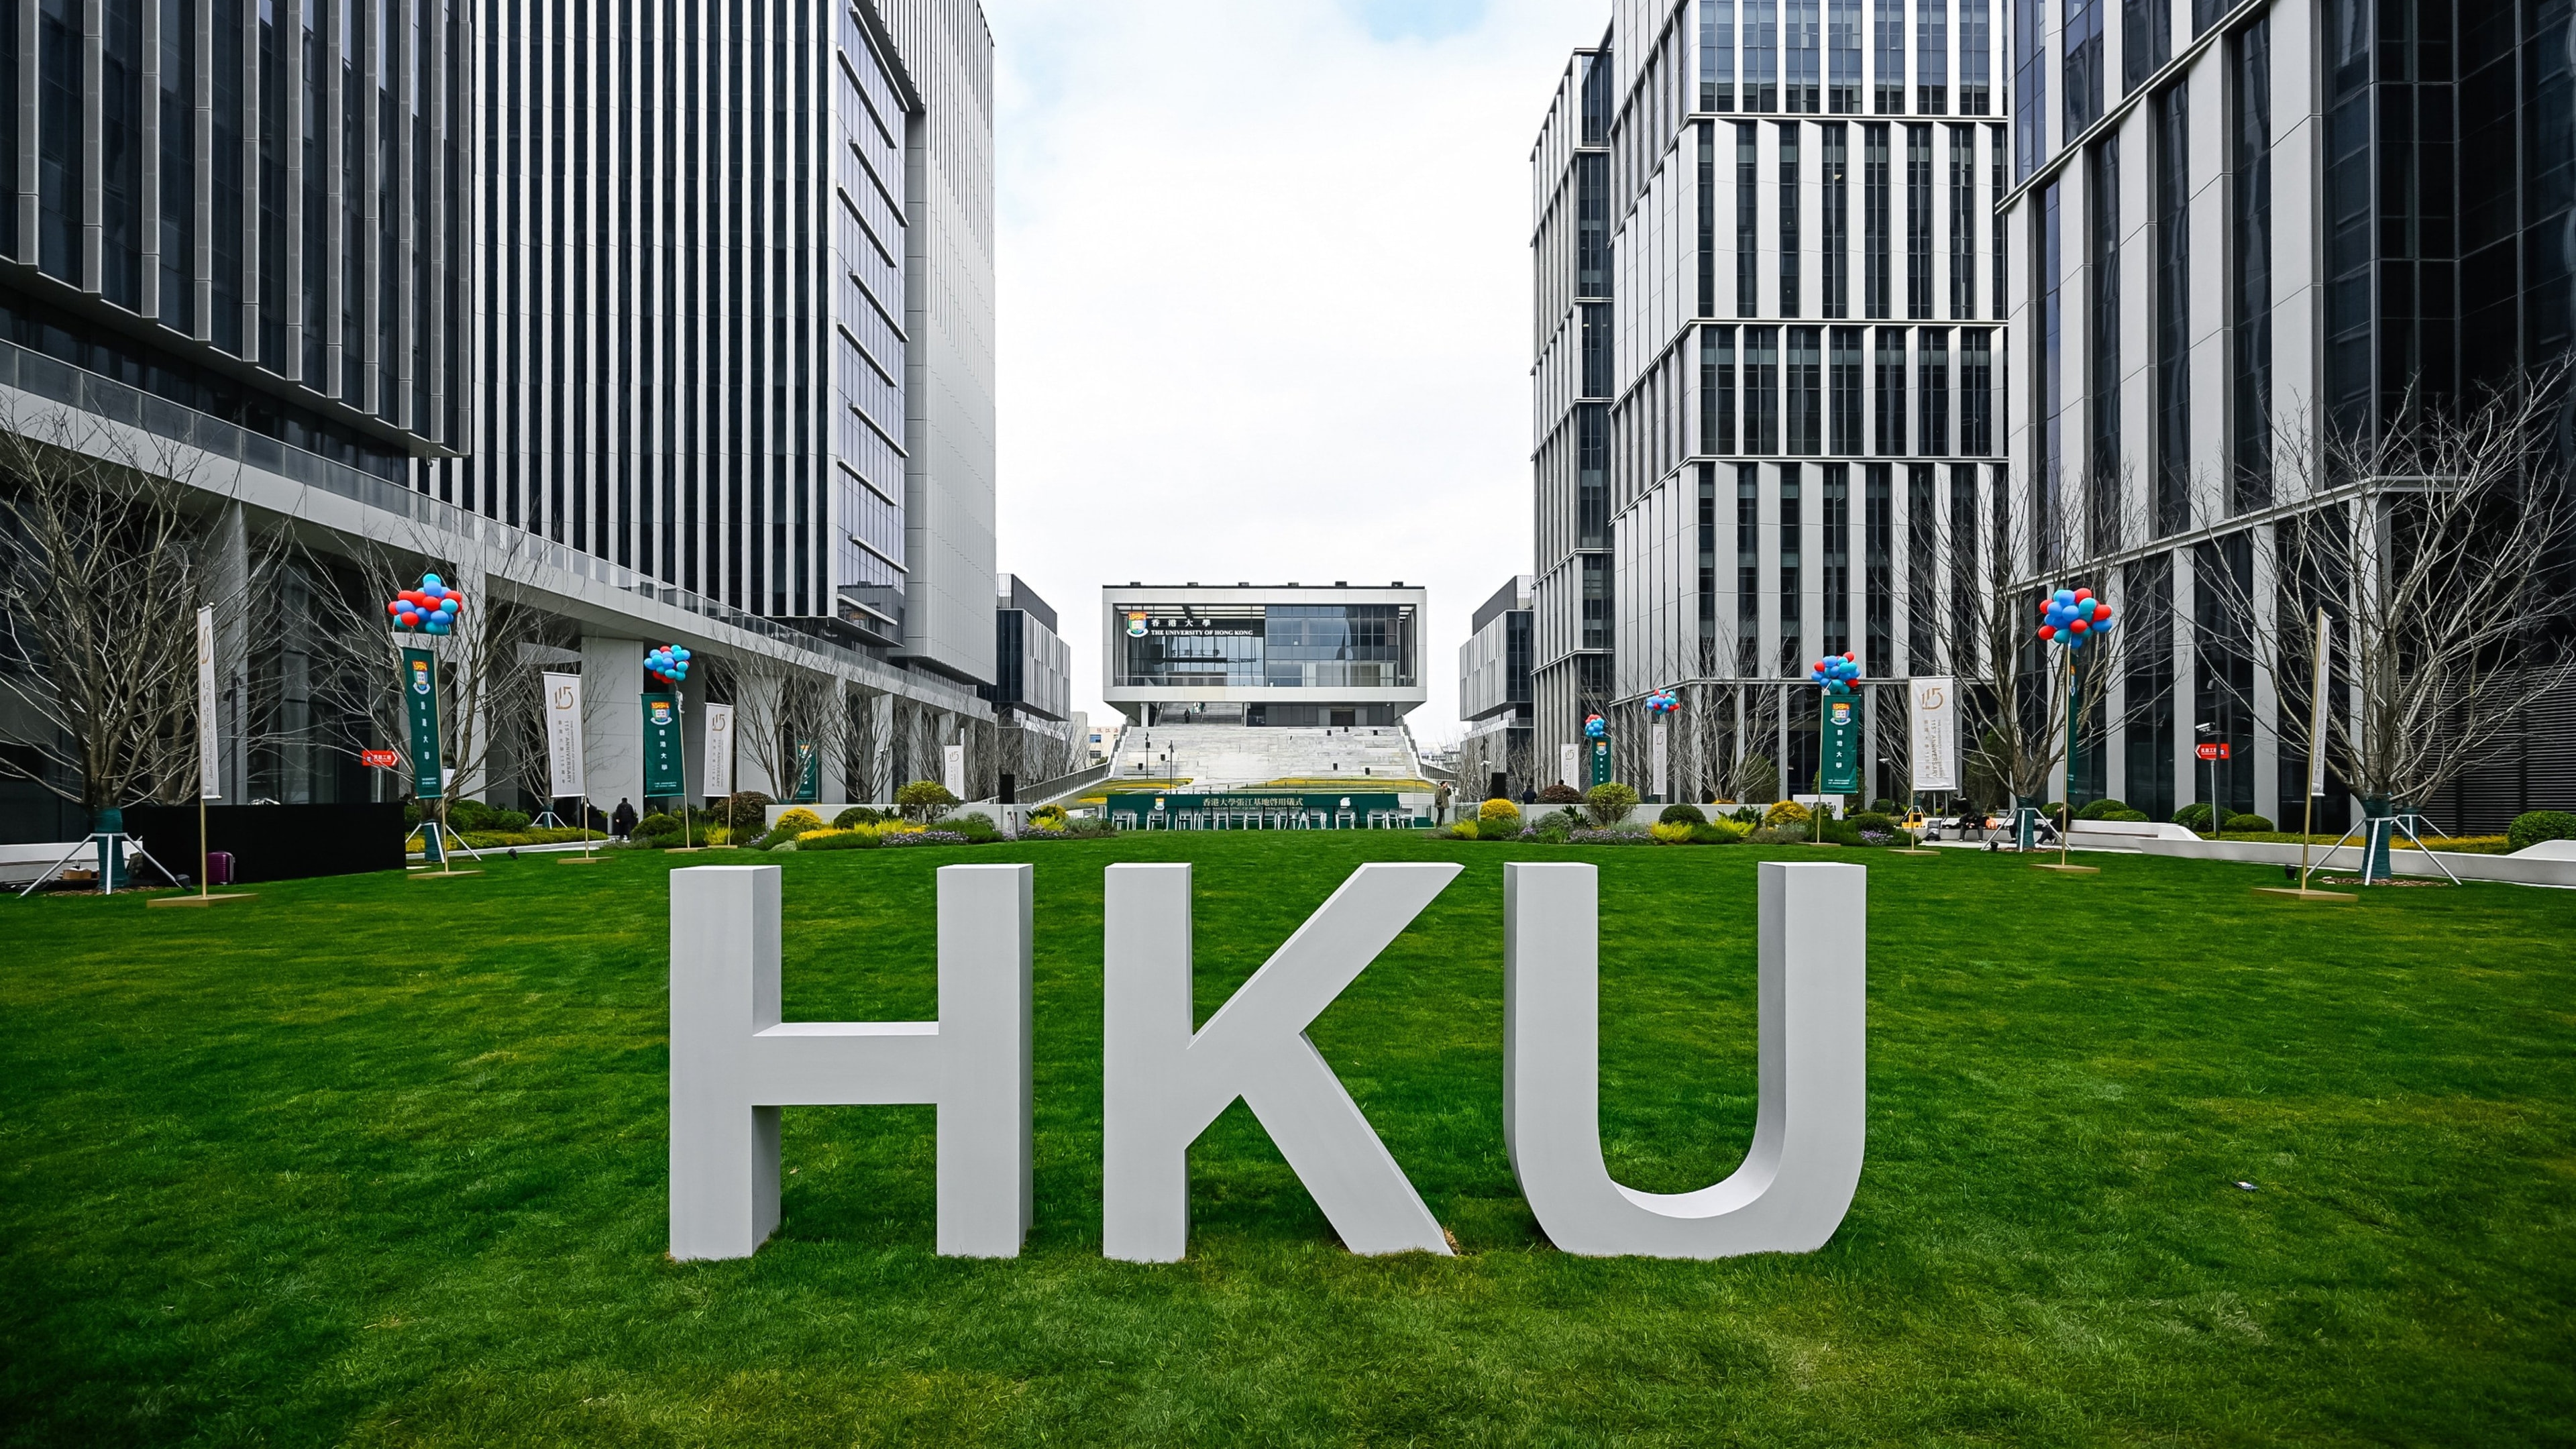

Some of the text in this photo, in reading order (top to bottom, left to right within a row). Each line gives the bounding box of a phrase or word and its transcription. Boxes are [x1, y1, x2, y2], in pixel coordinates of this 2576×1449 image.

[1151, 619, 1211, 627] 香港大學
[669, 861, 1868, 1262] HKU
